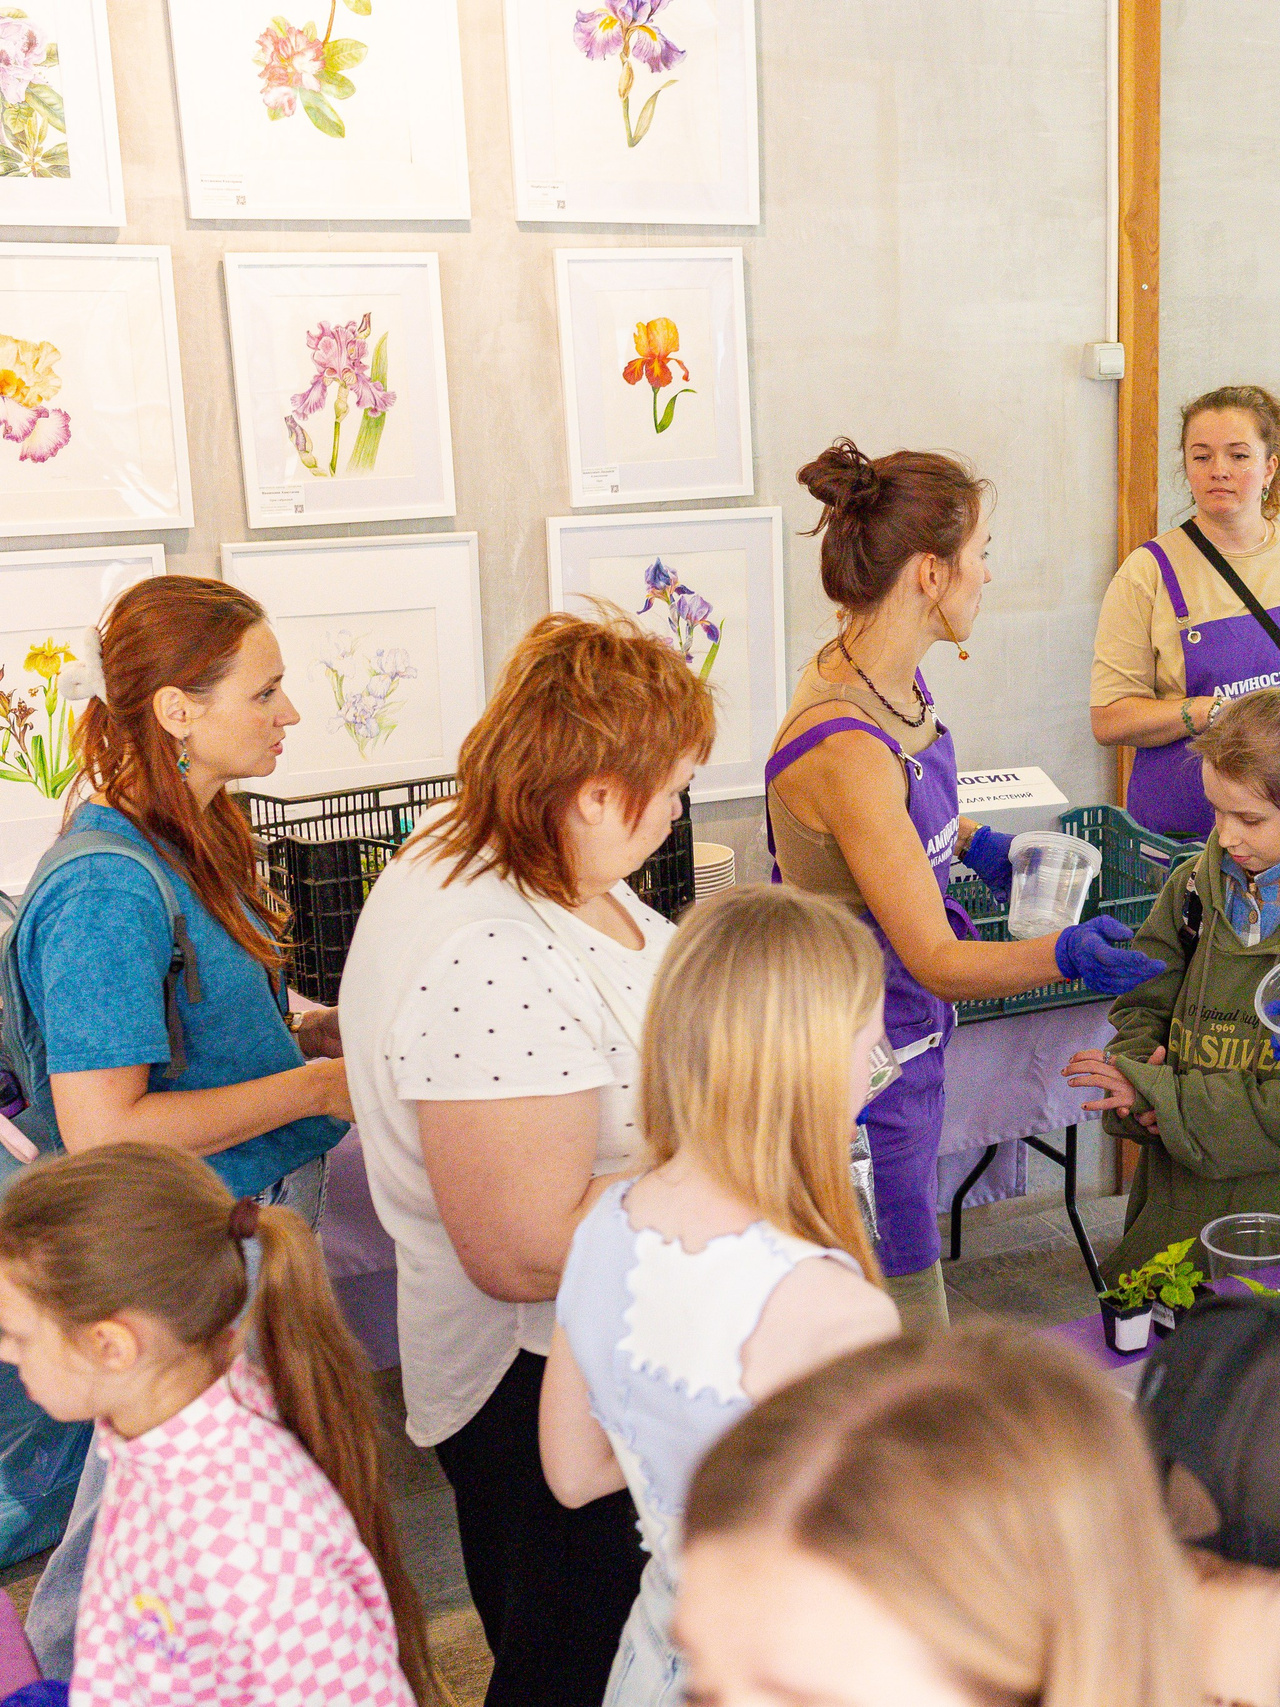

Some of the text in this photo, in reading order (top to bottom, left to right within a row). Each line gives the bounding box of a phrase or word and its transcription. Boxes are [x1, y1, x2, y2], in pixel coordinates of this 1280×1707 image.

[966, 796, 985, 804] ДЛЯ
[987, 791, 1034, 801] РАСТЕНИЙ
[1210, 1023, 1236, 1034] 1969
